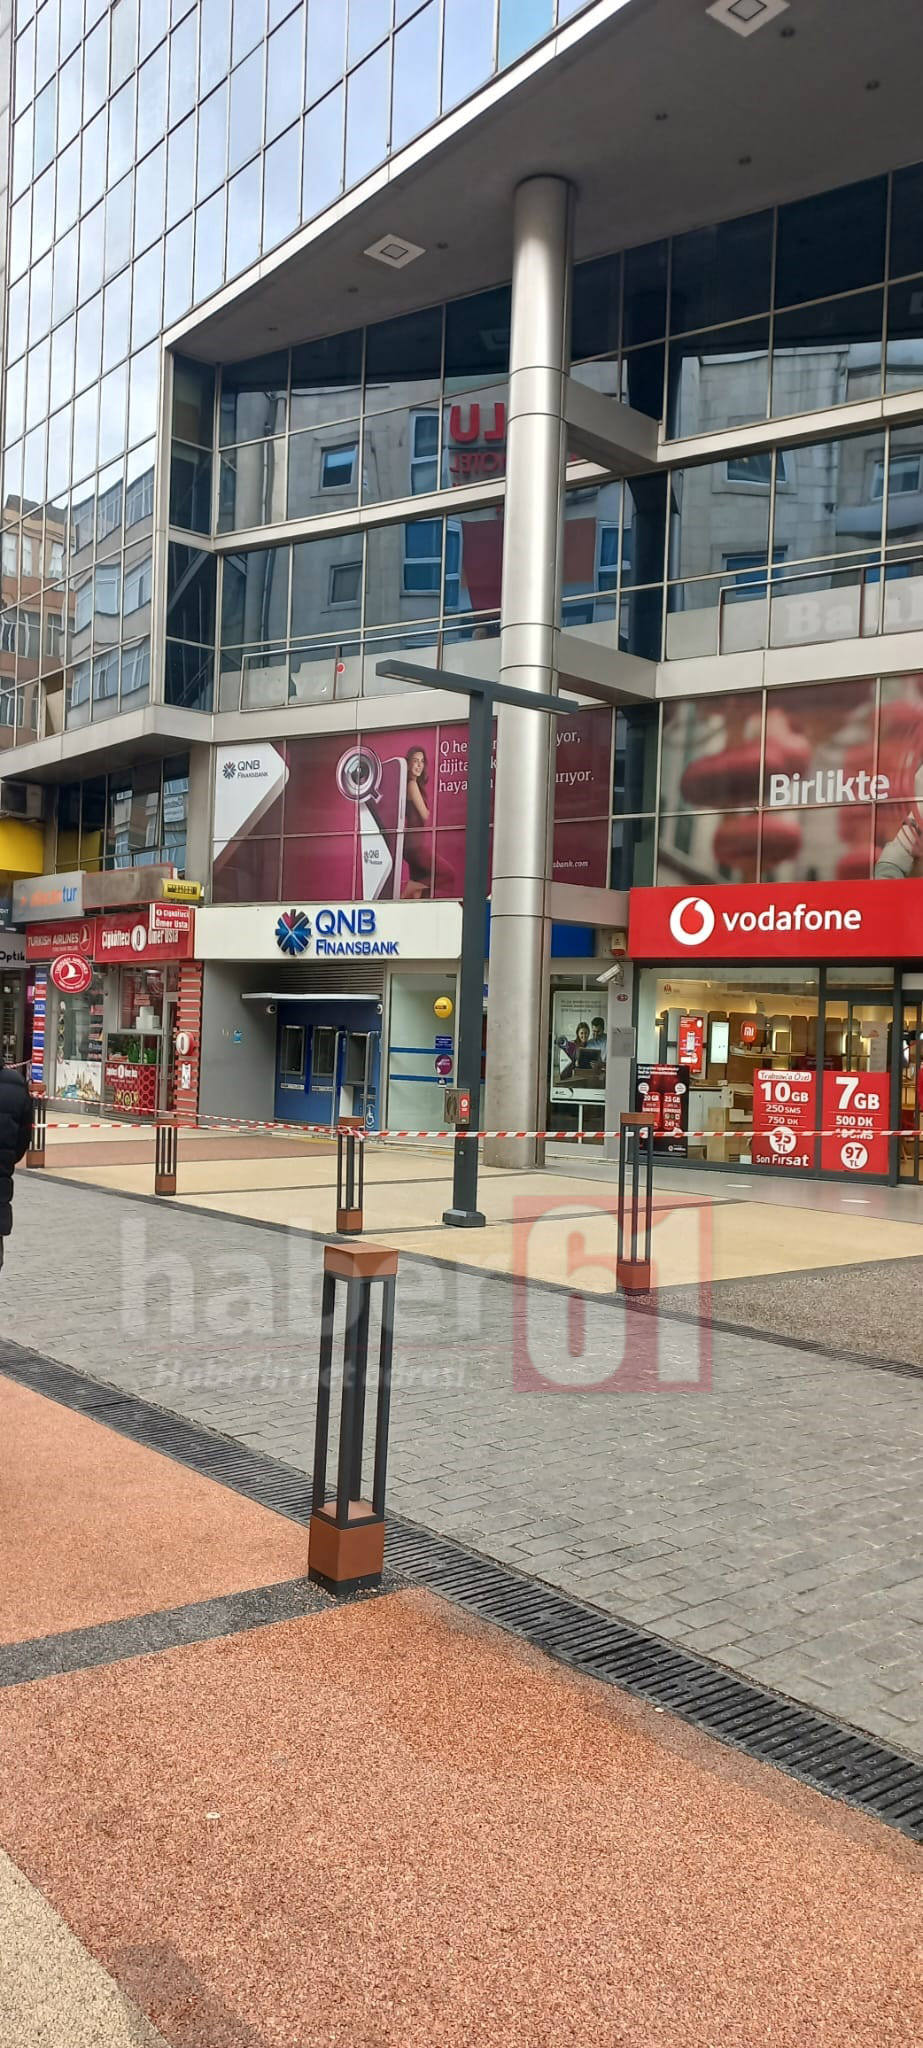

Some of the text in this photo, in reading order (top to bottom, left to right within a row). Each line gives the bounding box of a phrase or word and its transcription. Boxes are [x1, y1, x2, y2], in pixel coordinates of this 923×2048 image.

[440, 731, 581, 756] Q he yor,
[237, 760, 260, 771] QNB
[439, 759, 469, 775] dijita
[439, 770, 594, 794] haya ırıyor.
[769, 769, 890, 806] Birlikte
[315, 909, 376, 935] QNB
[722, 903, 862, 931] vodafone
[28, 932, 79, 947] TURKISH AIRLINES
[316, 939, 399, 955] FINANSBANK
[767, 1116, 785, 1124] 750
[835, 1116, 873, 1127] 500 DK
[776, 1144, 788, 1152] TL
[845, 1146, 864, 1159] 97
[756, 1154, 810, 1166] Son Fırsat
[849, 1159, 859, 1167] TL
